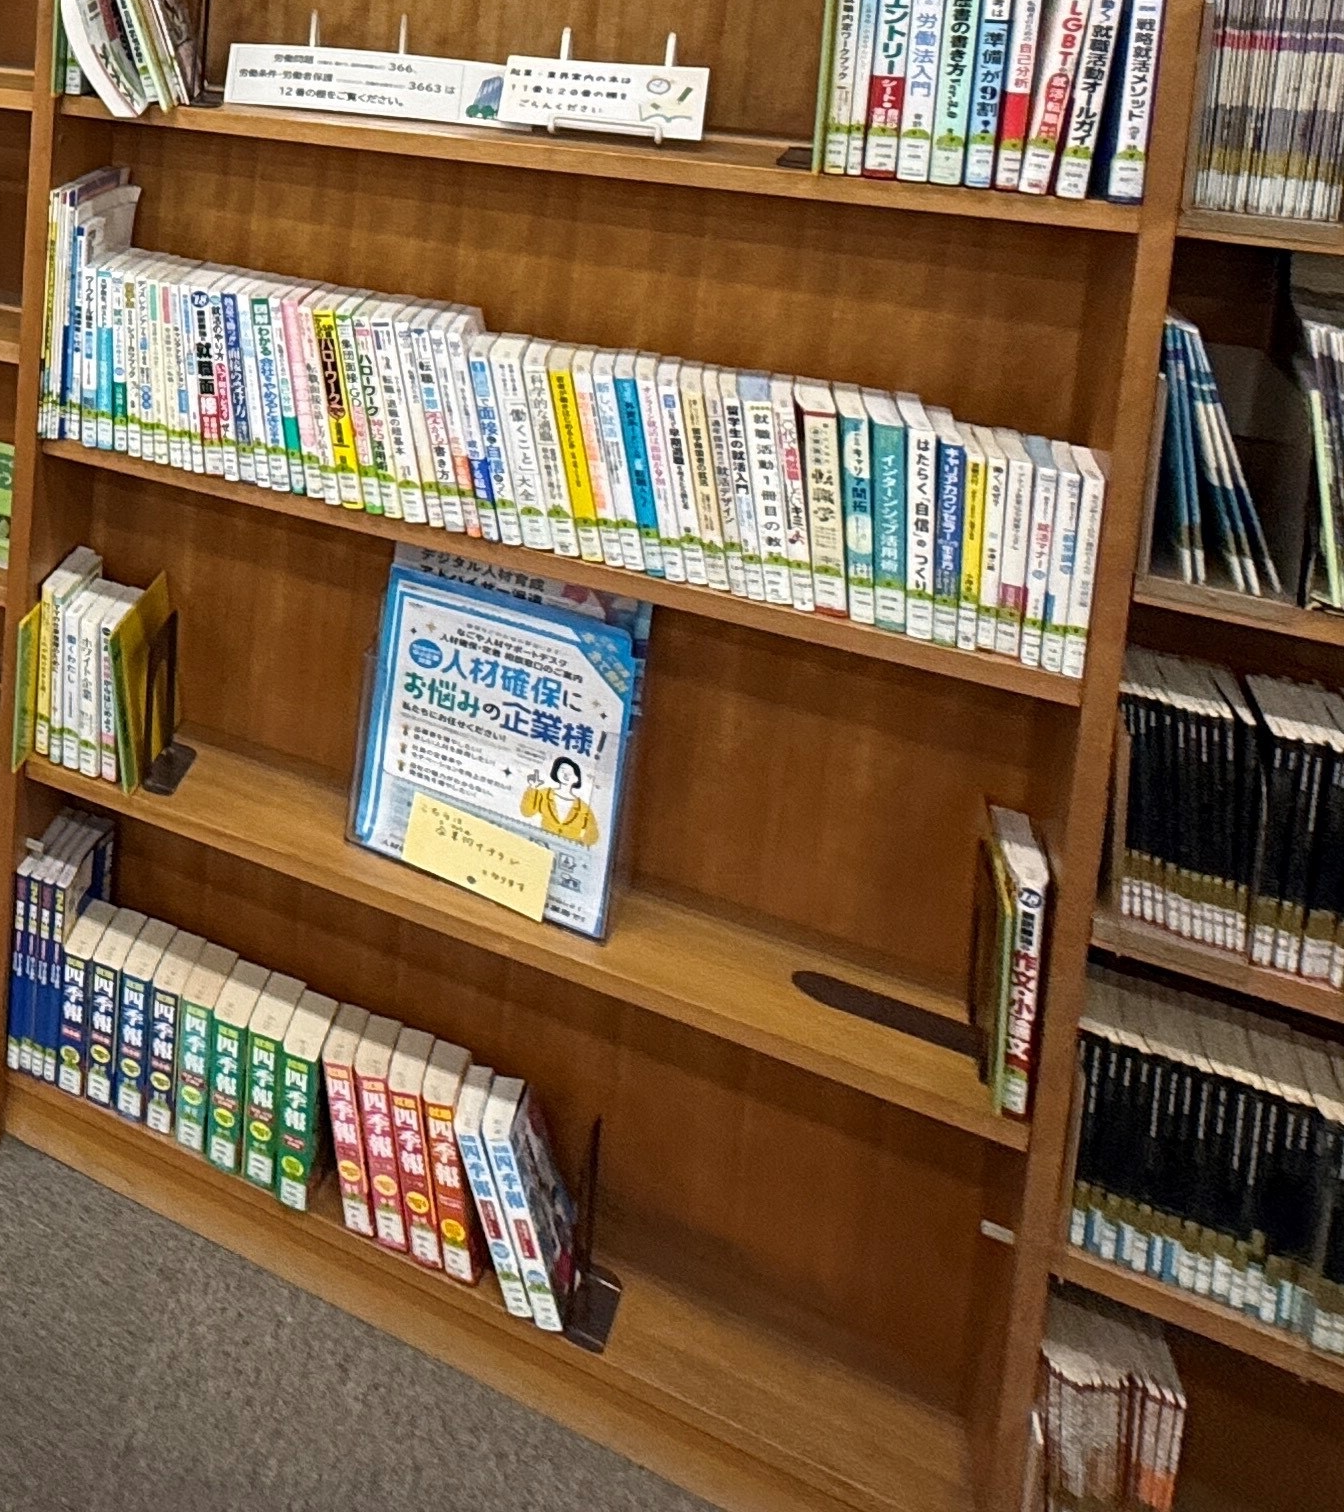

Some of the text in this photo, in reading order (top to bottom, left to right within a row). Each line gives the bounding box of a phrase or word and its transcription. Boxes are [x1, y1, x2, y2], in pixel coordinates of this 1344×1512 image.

[273, 53, 314, 65] 労働問題
[408, 80, 442, 94] 3663
[444, 85, 456, 95] は
[910, 13, 939, 98] 労働法入門
[1014, 43, 1032, 88] 自己分析
[321, 339, 342, 406] ハローワーク
[360, 354, 379, 417] ハローワーク
[726, 405, 750, 496] 留学生の就活入門
[441, 649, 583, 713] 人材確保に
[403, 671, 608, 761] お悩みの企業様!
[1007, 952, 1038, 1061] 作文・小論文
